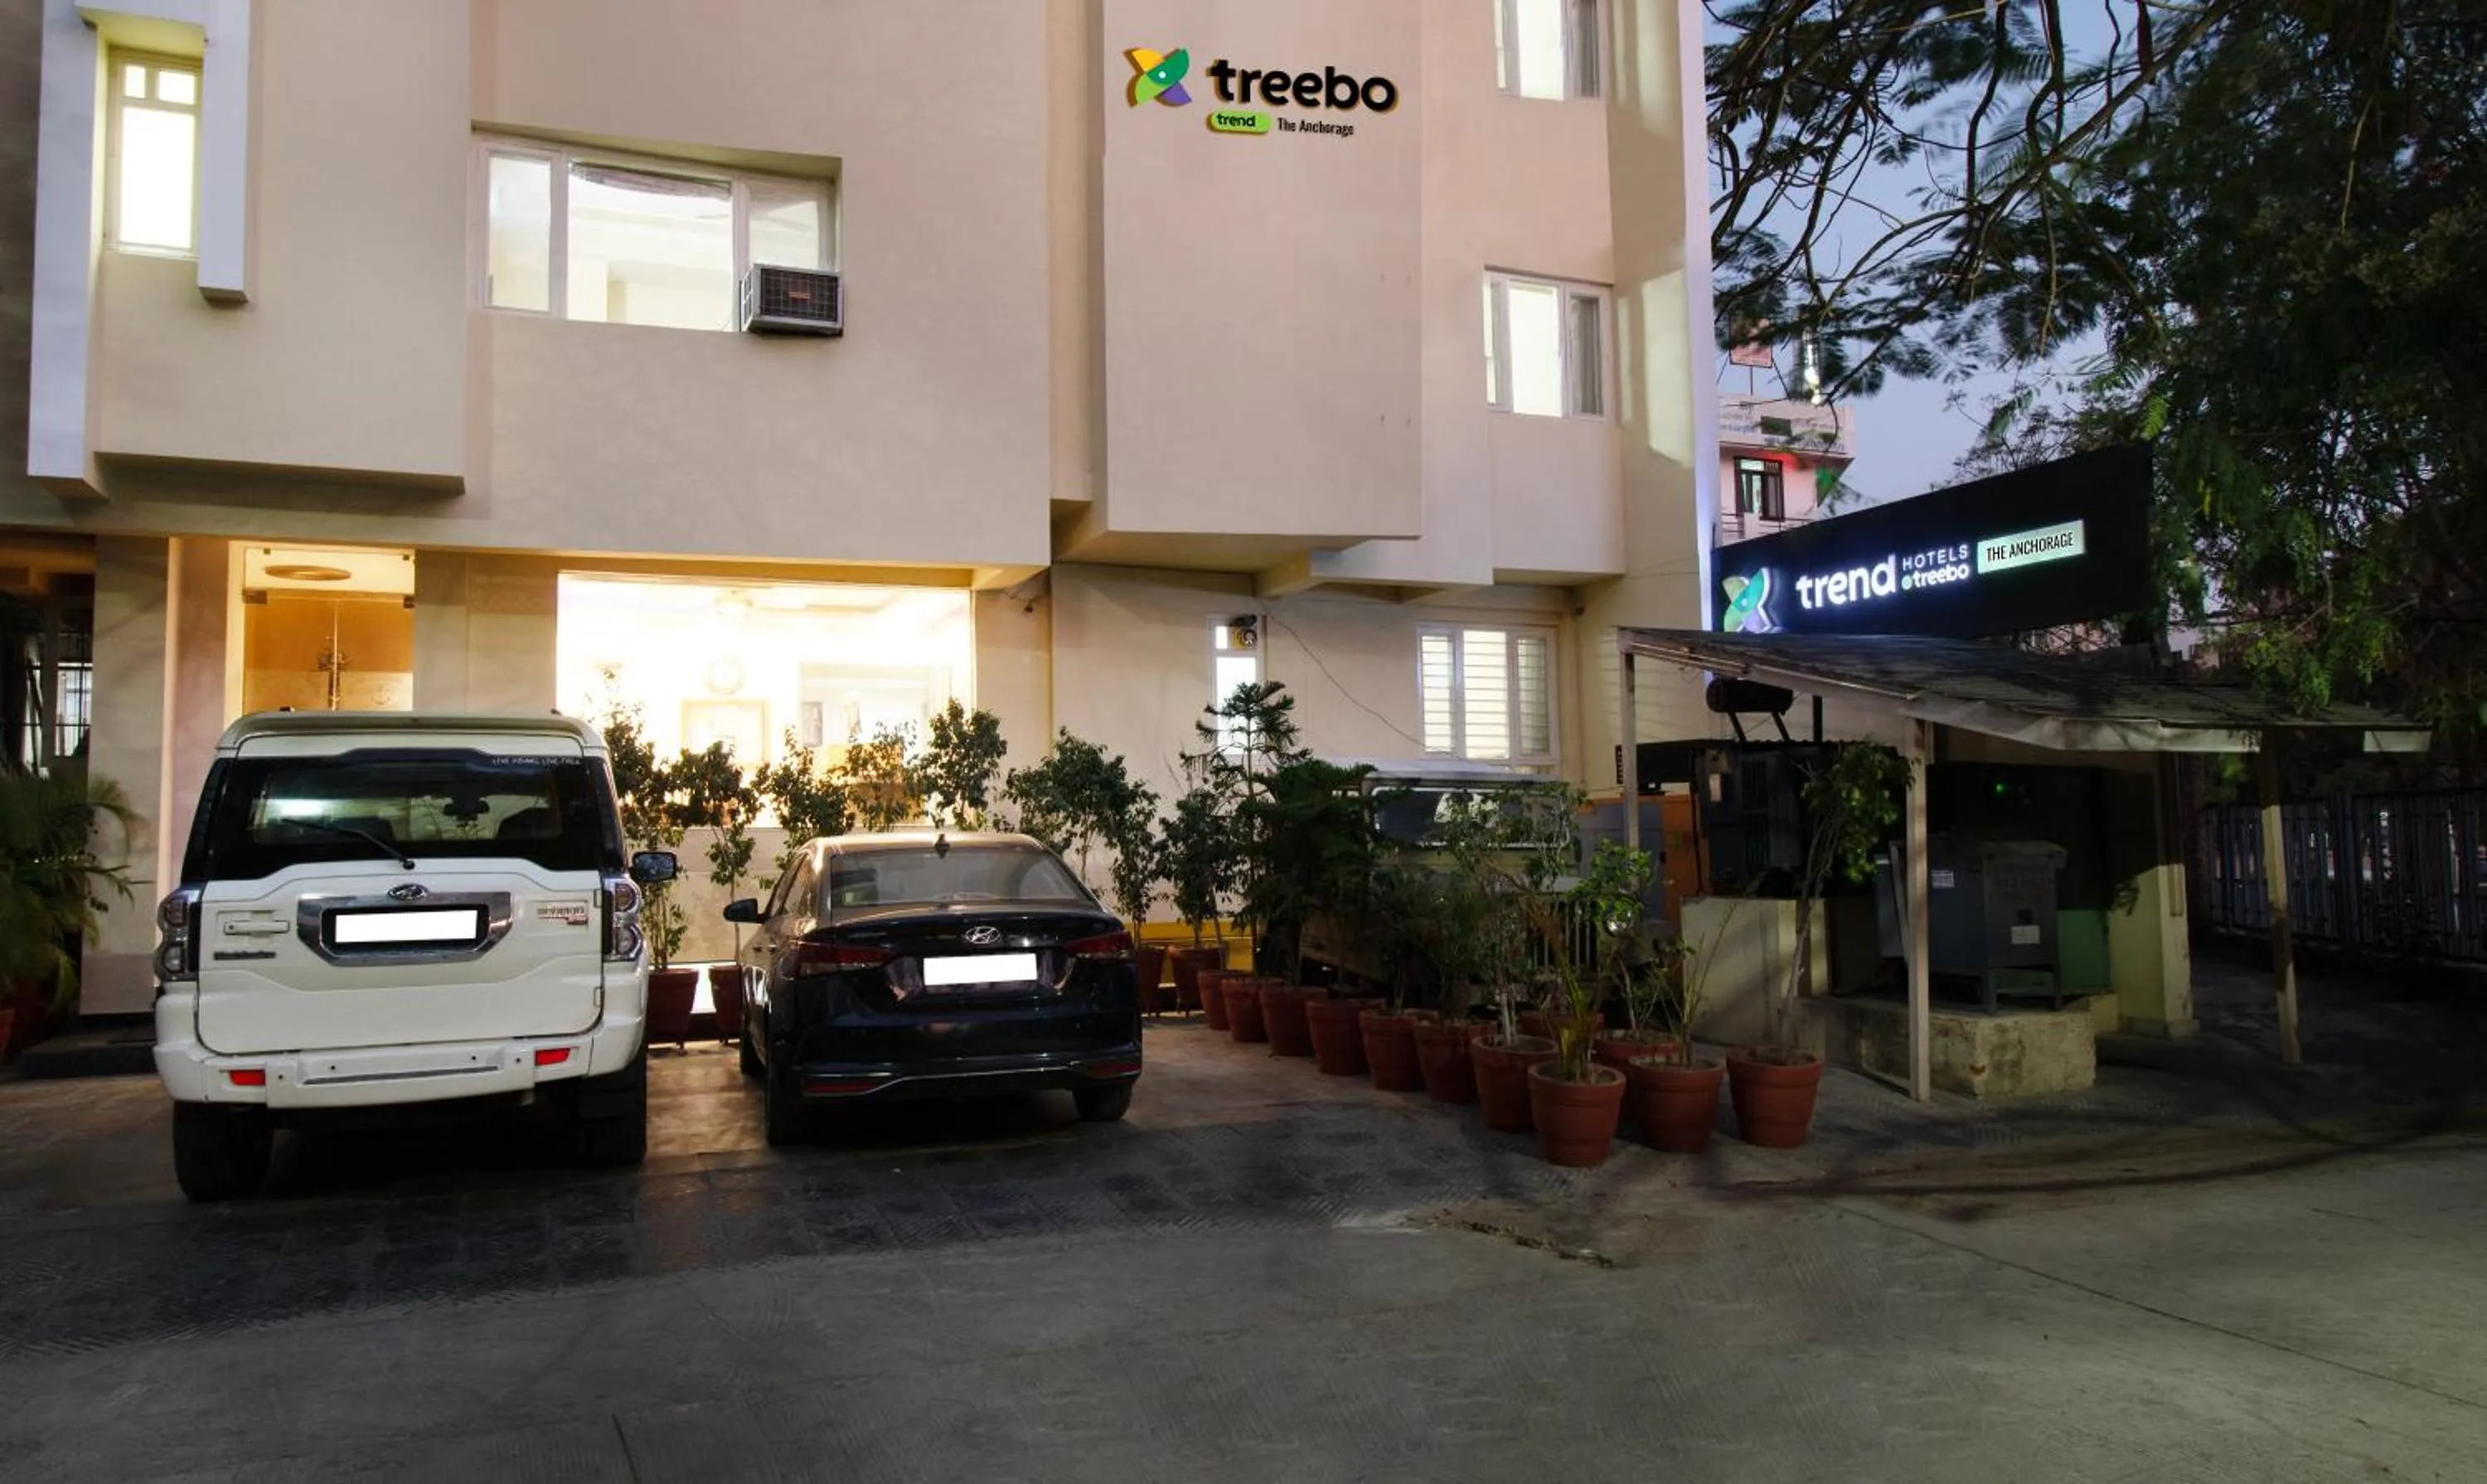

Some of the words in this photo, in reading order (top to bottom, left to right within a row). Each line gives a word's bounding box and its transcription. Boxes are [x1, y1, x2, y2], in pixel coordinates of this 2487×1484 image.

[1207, 58, 1399, 112] treebo
[1216, 113, 1256, 128] trend
[1277, 118, 1296, 133] The
[1299, 120, 1354, 137] Anchorage
[1903, 544, 1969, 570] HOTELS
[1986, 546, 2007, 563] THE
[2009, 531, 2074, 559] ANCHORAGE
[1796, 555, 1897, 609] trend
[1912, 564, 1970, 589] treebo
